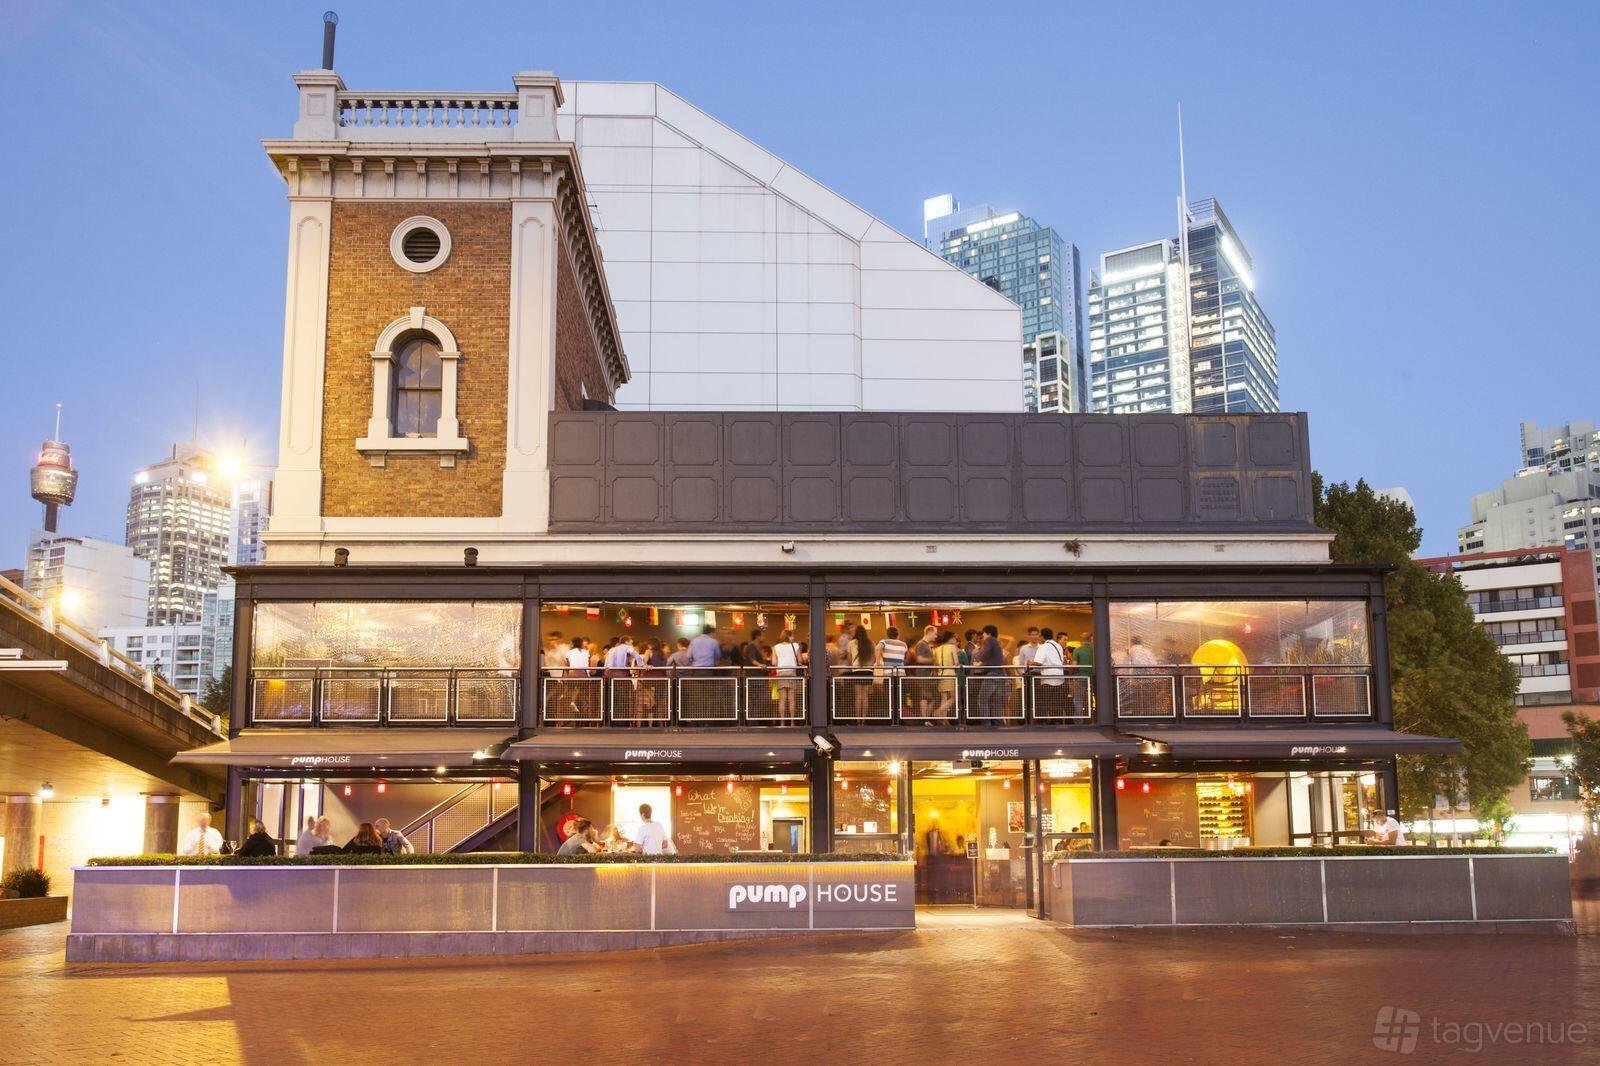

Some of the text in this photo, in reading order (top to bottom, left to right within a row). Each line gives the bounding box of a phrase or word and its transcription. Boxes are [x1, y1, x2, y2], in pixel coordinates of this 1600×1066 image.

[625, 750, 682, 760] pumpHOUSE
[962, 749, 1019, 760] pumpHOUSE
[1291, 746, 1346, 756] pumpHOU
[291, 756, 350, 765] pumpHOUSE
[688, 790, 716, 801] What
[729, 884, 898, 908] pump HOUSE
